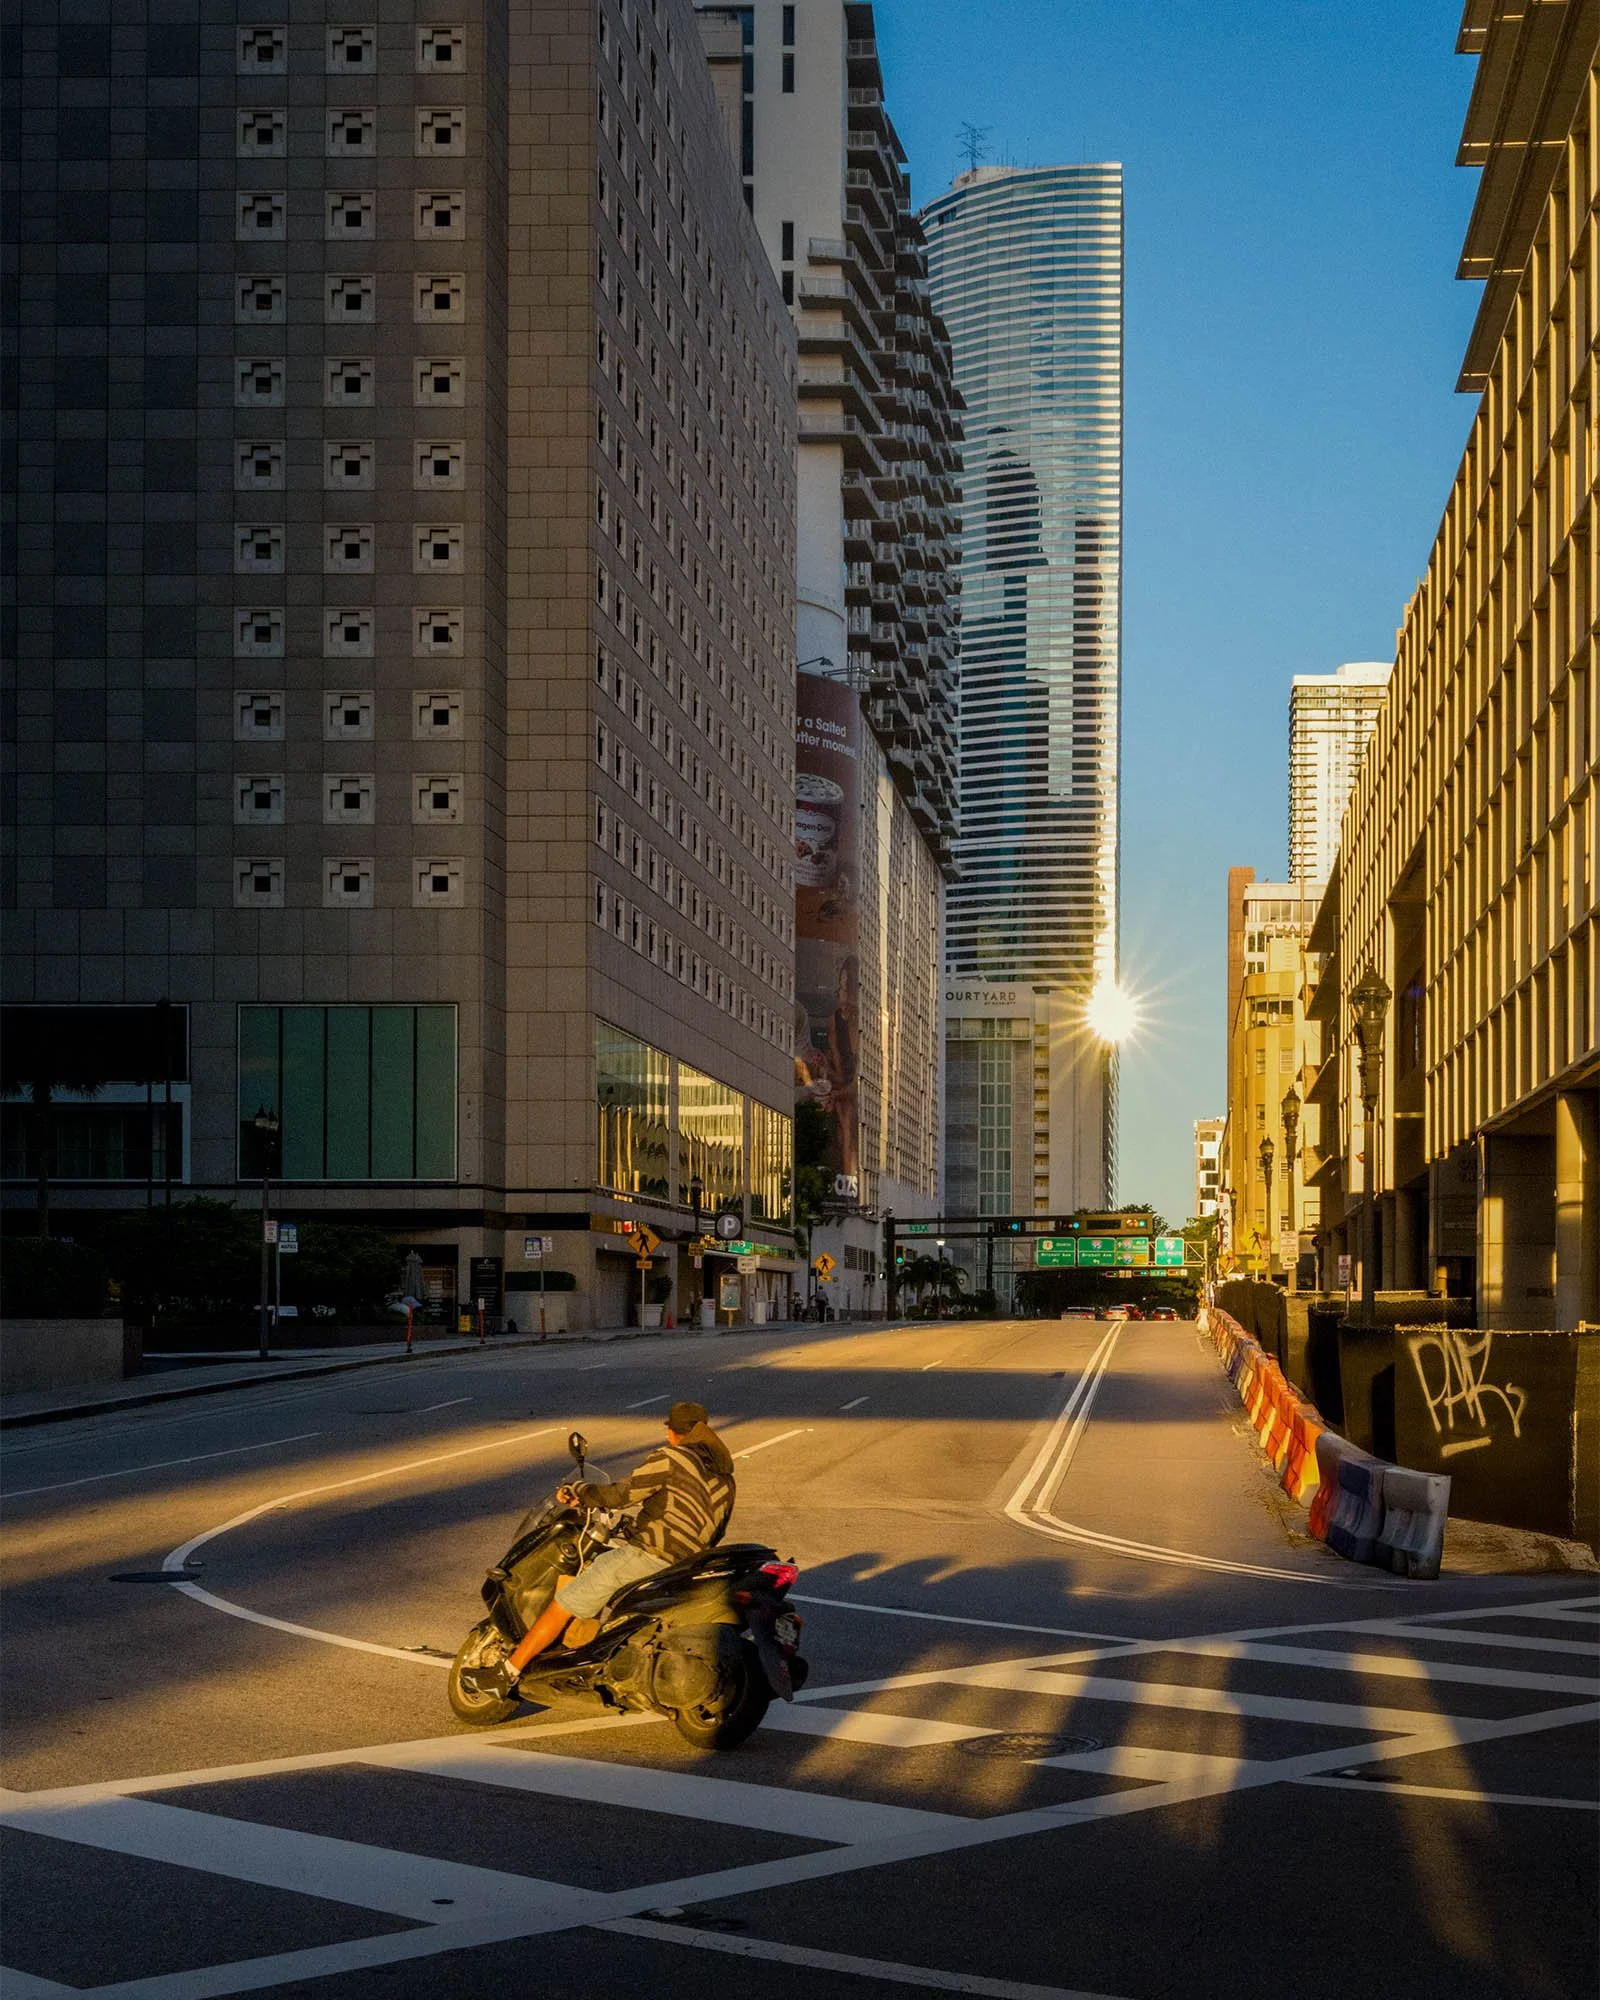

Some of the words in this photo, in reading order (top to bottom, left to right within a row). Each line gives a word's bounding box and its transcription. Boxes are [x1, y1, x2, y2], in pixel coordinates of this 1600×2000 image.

[804, 718, 813, 728] a
[816, 717, 847, 737] Salted
[723, 1217, 735, 1235] P
